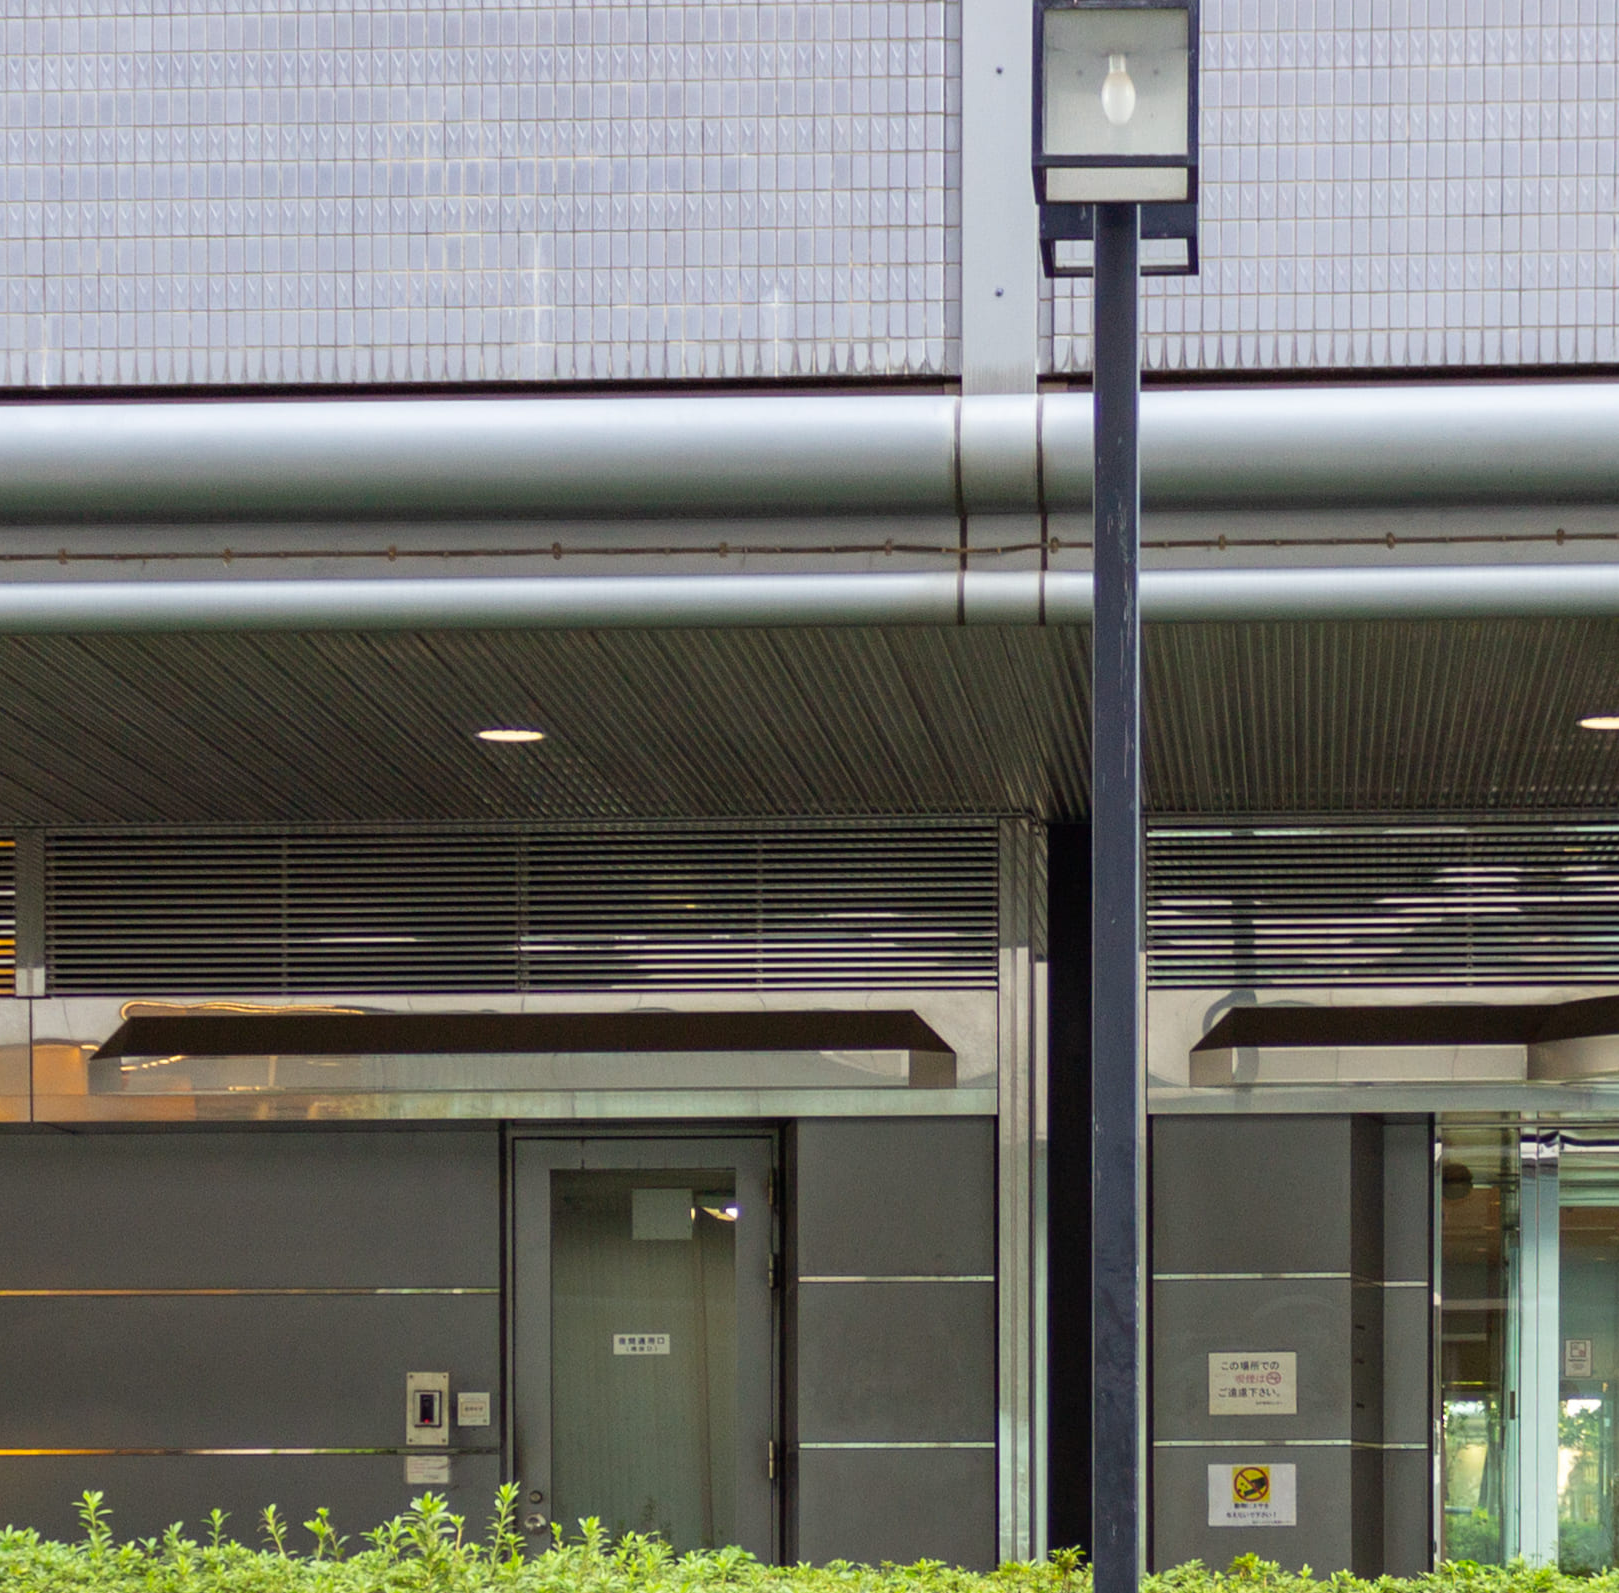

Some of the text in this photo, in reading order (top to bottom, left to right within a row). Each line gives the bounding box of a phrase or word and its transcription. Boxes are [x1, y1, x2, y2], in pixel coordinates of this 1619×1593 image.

[1221, 1361, 1280, 1371] この場所での
[1235, 1374, 1265, 1385] 喫煙は
